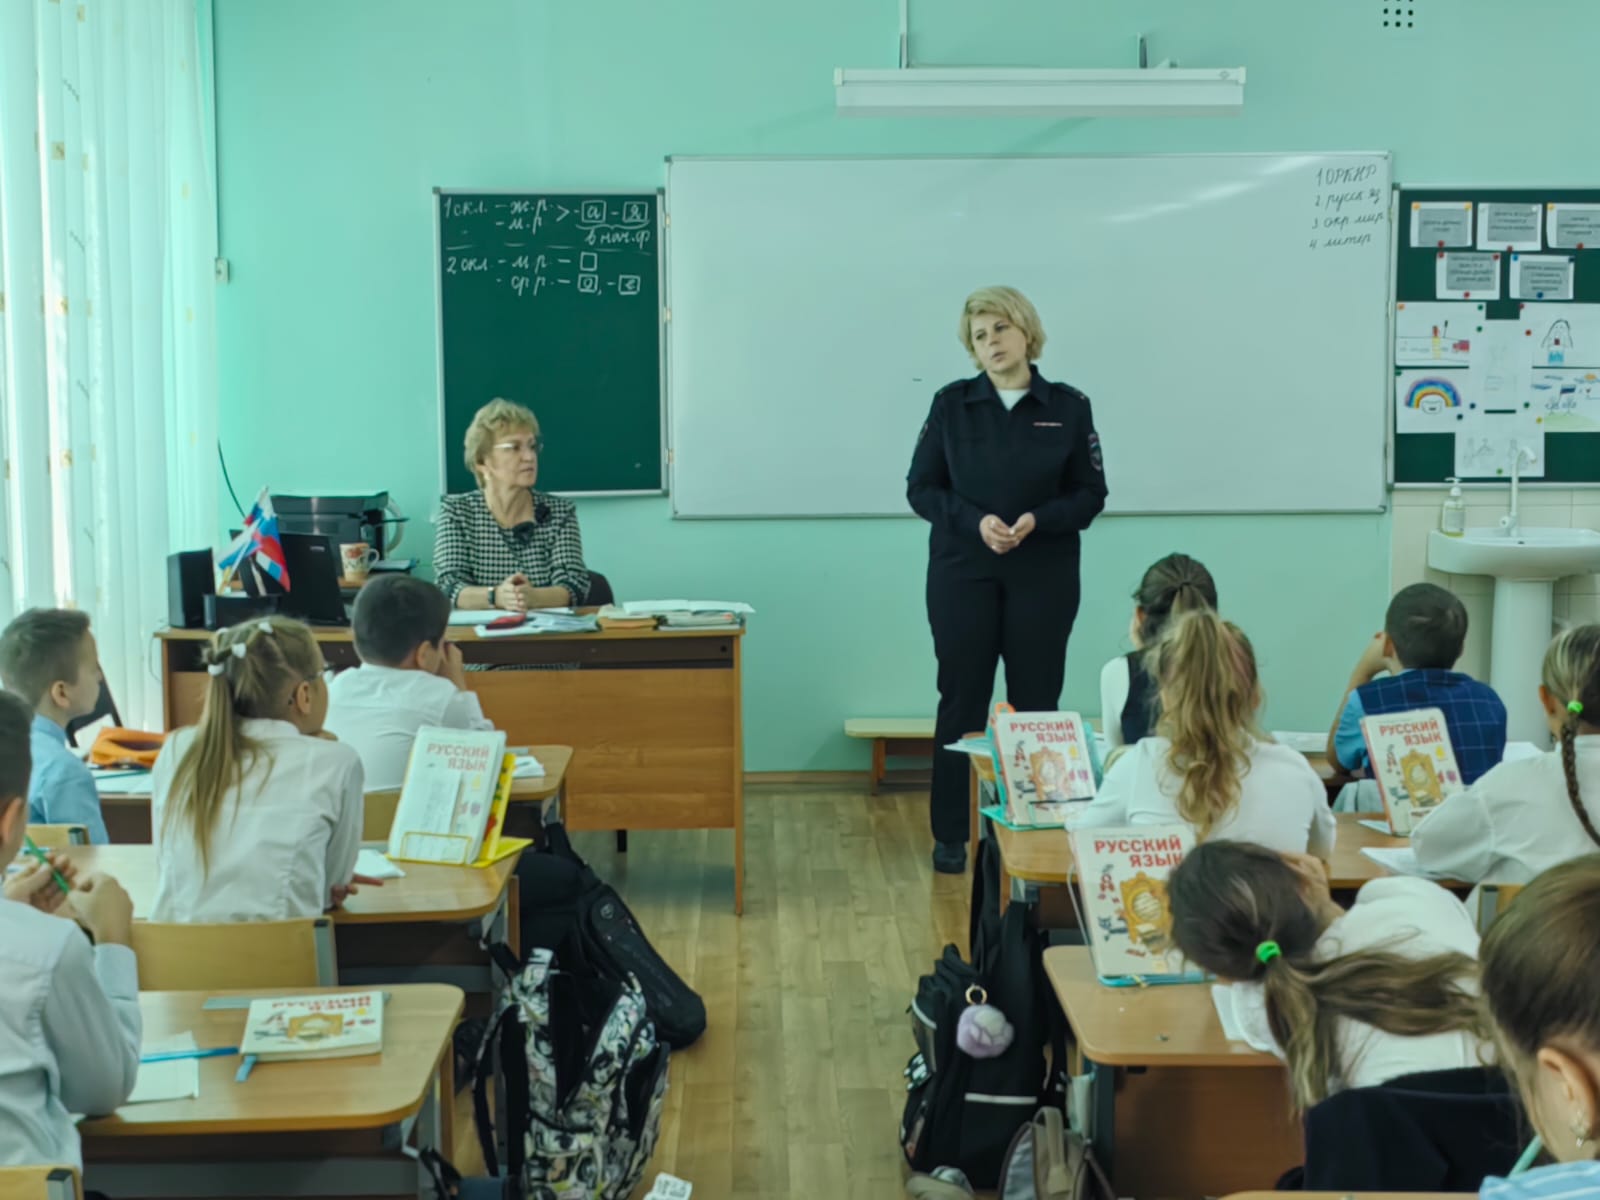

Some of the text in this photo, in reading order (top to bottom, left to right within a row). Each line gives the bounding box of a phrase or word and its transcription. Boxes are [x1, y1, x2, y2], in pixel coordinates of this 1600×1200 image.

[447, 256, 457, 274] 2
[1010, 720, 1075, 733] РУССКИЙ
[1379, 717, 1439, 736] РУССКИЙ
[1036, 733, 1078, 744] ЯЗЫК
[1404, 732, 1443, 746] ЯЗЫК
[426, 743, 490, 758] РУССКИЙ
[448, 757, 488, 771] ЯЗЫК
[1093, 834, 1182, 854] РУССКИЙ
